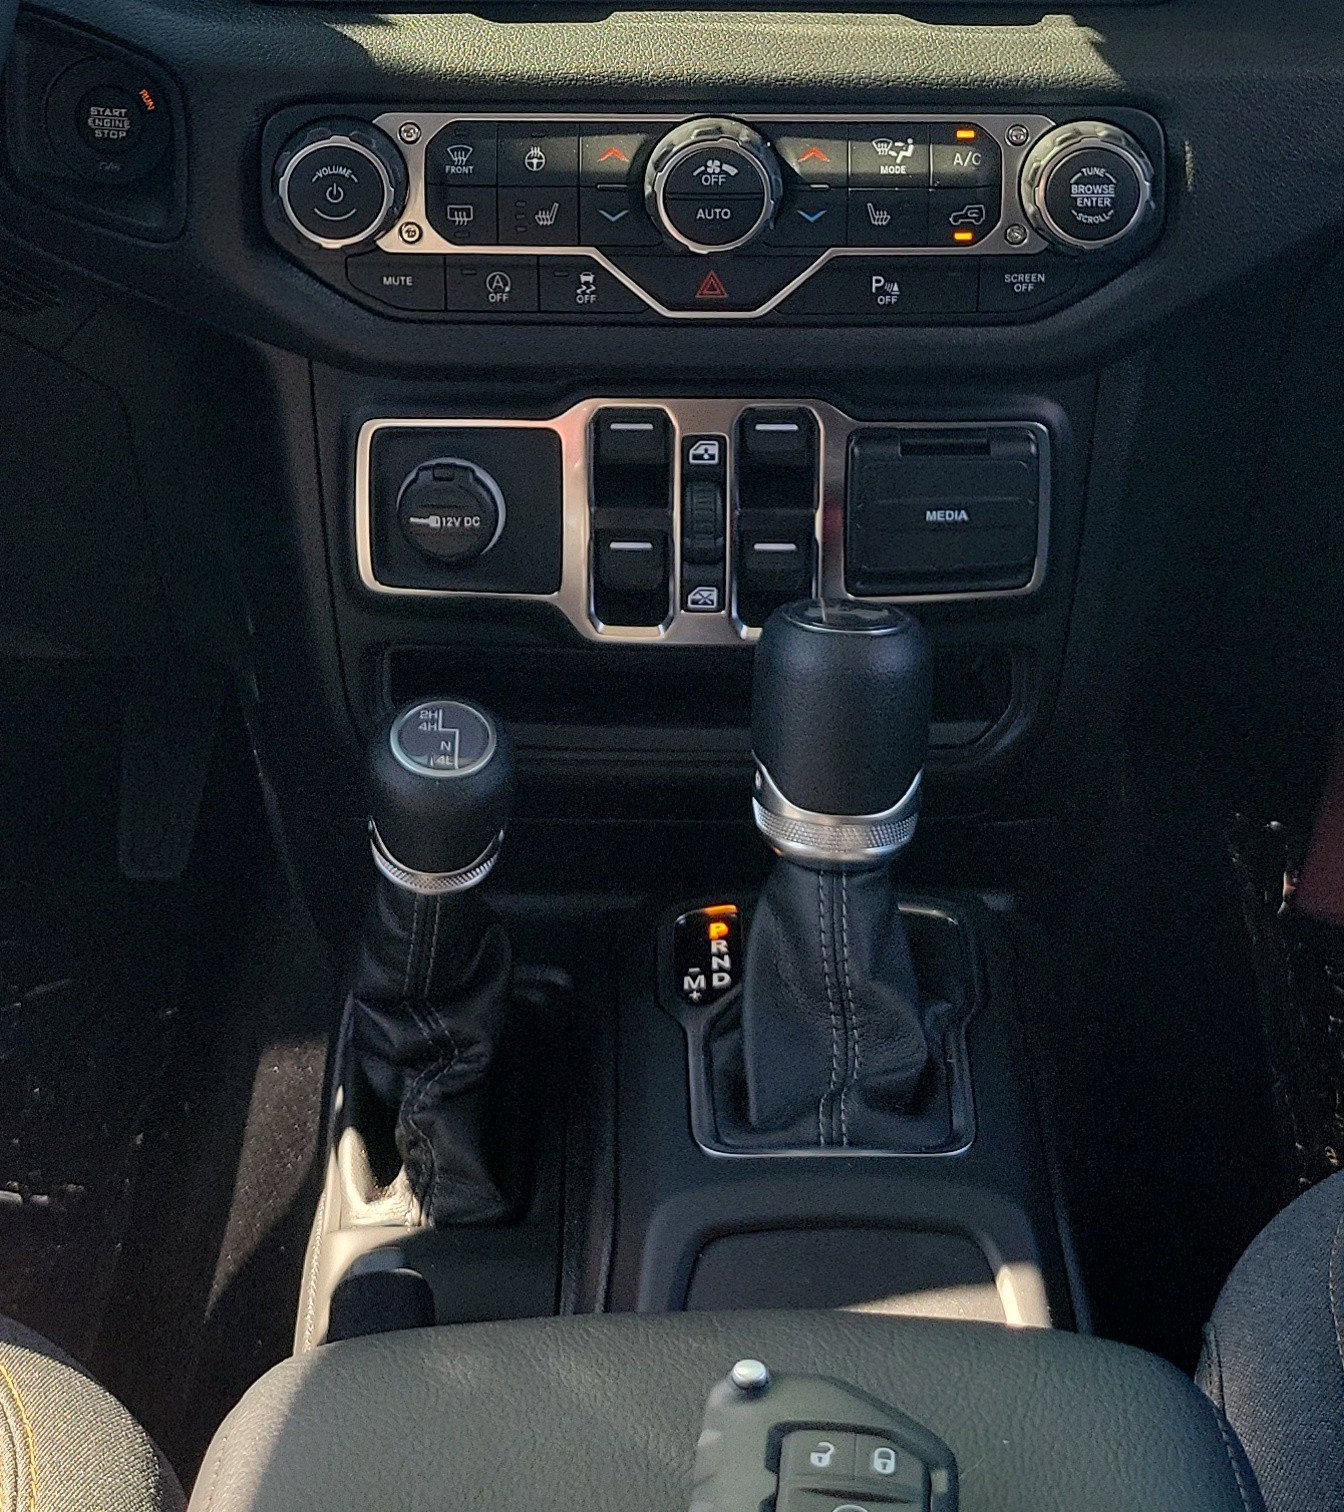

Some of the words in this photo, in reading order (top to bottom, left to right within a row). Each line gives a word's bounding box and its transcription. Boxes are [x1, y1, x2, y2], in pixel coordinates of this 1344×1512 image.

[138, 88, 156, 112] RUN
[90, 106, 128, 117] START
[87, 118, 131, 128] ENGINE
[94, 129, 127, 139] STOP
[952, 151, 981, 167] A/C
[315, 165, 353, 180] VOLUME
[445, 165, 474, 175] FRONT
[879, 165, 907, 175] MODE
[1081, 168, 1105, 178] TUNE
[701, 174, 727, 186] OFF
[1070, 184, 1115, 195] BROWSE
[1076, 197, 1111, 207] ENTER
[696, 207, 731, 220] AUTO
[1075, 211, 1111, 224] SCROLL
[383, 276, 413, 286] MUTE
[1004, 273, 1045, 283] SCREEN
[1014, 283, 1034, 293] OFF
[488, 293, 509, 303] OFF
[575, 293, 597, 304] OFF
[877, 295, 898, 305] OFF
[925, 509, 969, 522] MEDIA
[440, 515, 463, 528] 12V
[464, 515, 481, 528] DC
[419, 709, 438, 719] 2H
[417, 721, 438, 731] 4H
[440, 740, 451, 752] N
[435, 754, 455, 766] 4L
[709, 922, 729, 940] P
[711, 940, 729, 955] R
[711, 954, 732, 971] N
[683, 974, 706, 991] M
[712, 972, 732, 989] D
